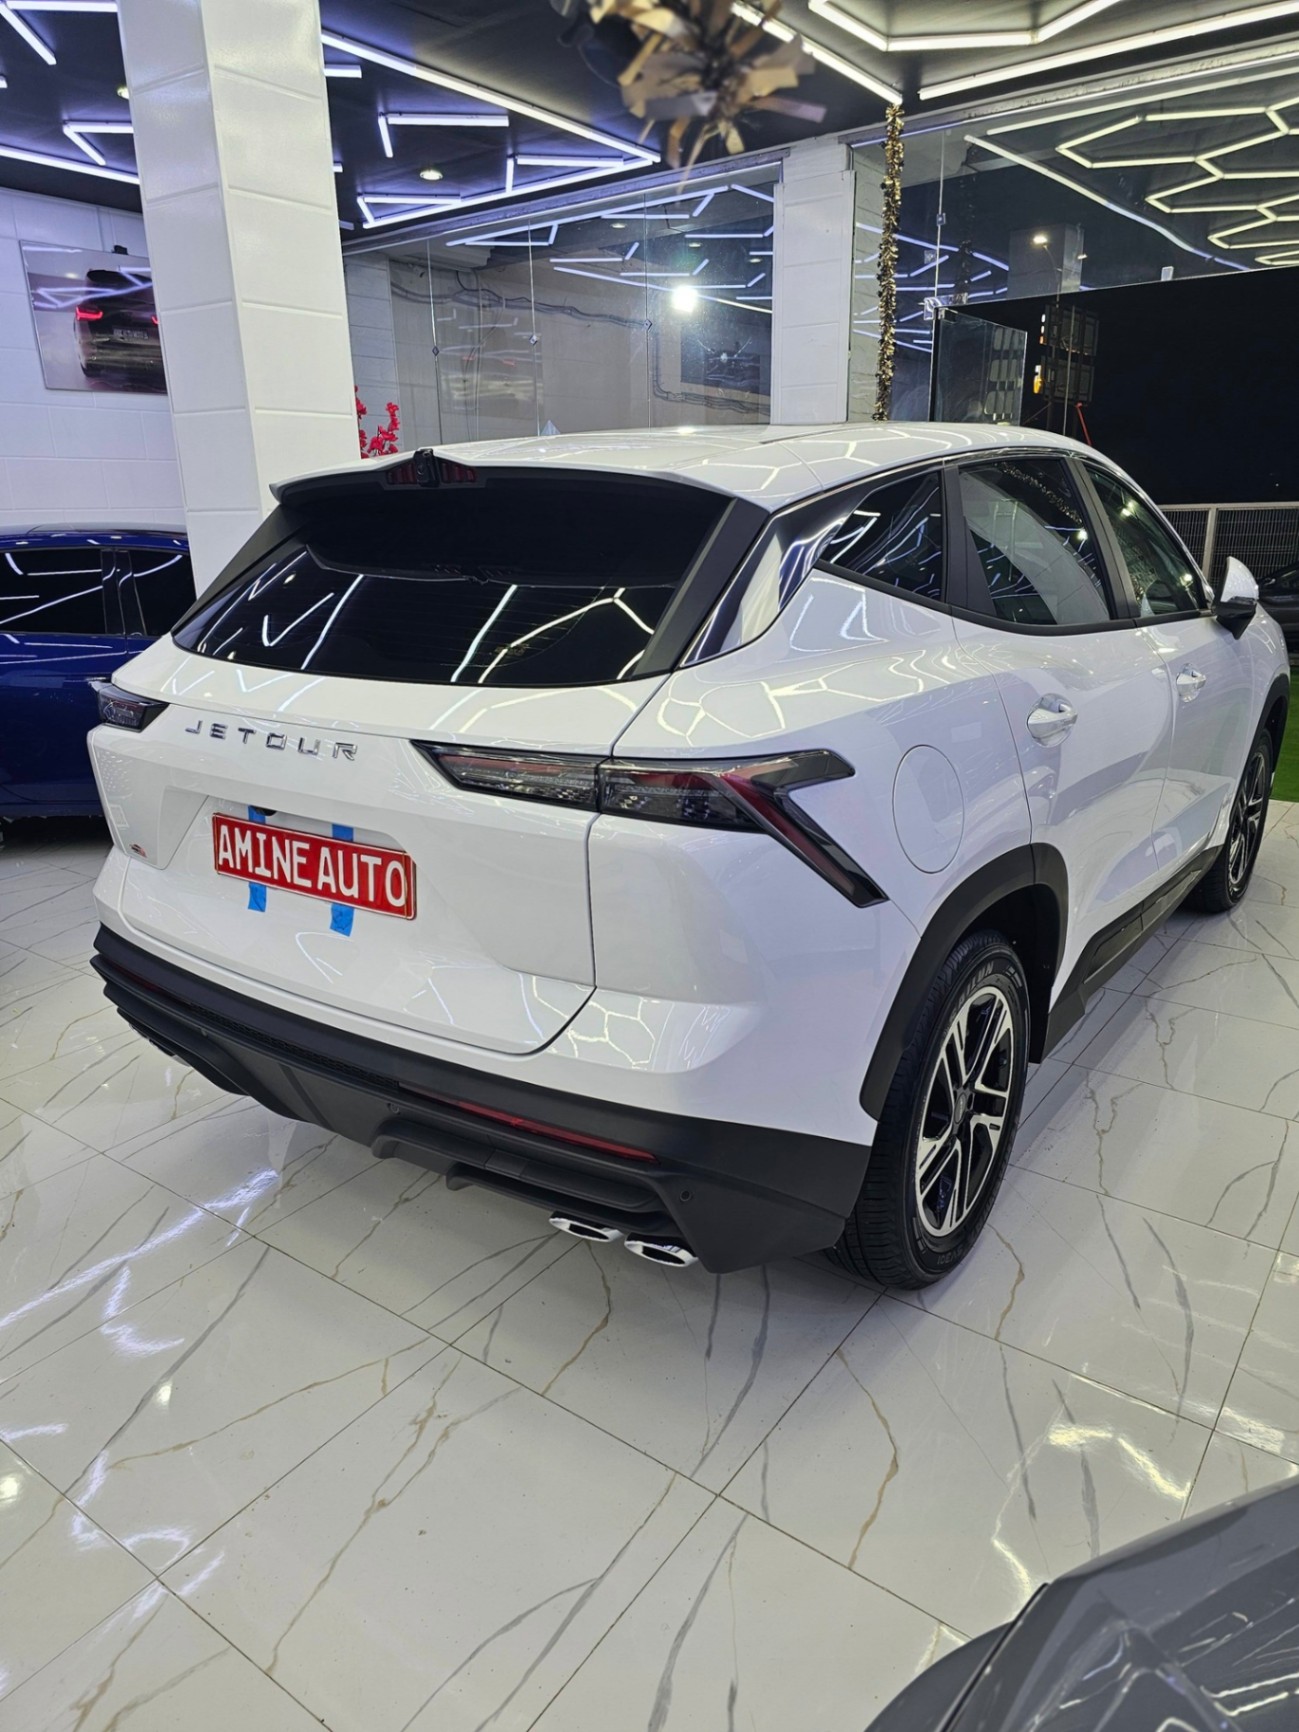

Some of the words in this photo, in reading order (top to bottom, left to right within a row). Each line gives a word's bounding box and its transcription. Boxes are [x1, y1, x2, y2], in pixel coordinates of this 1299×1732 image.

[185, 720, 358, 761] JETOUR
[218, 824, 312, 888] AMINE
[316, 845, 407, 907] AUTO
